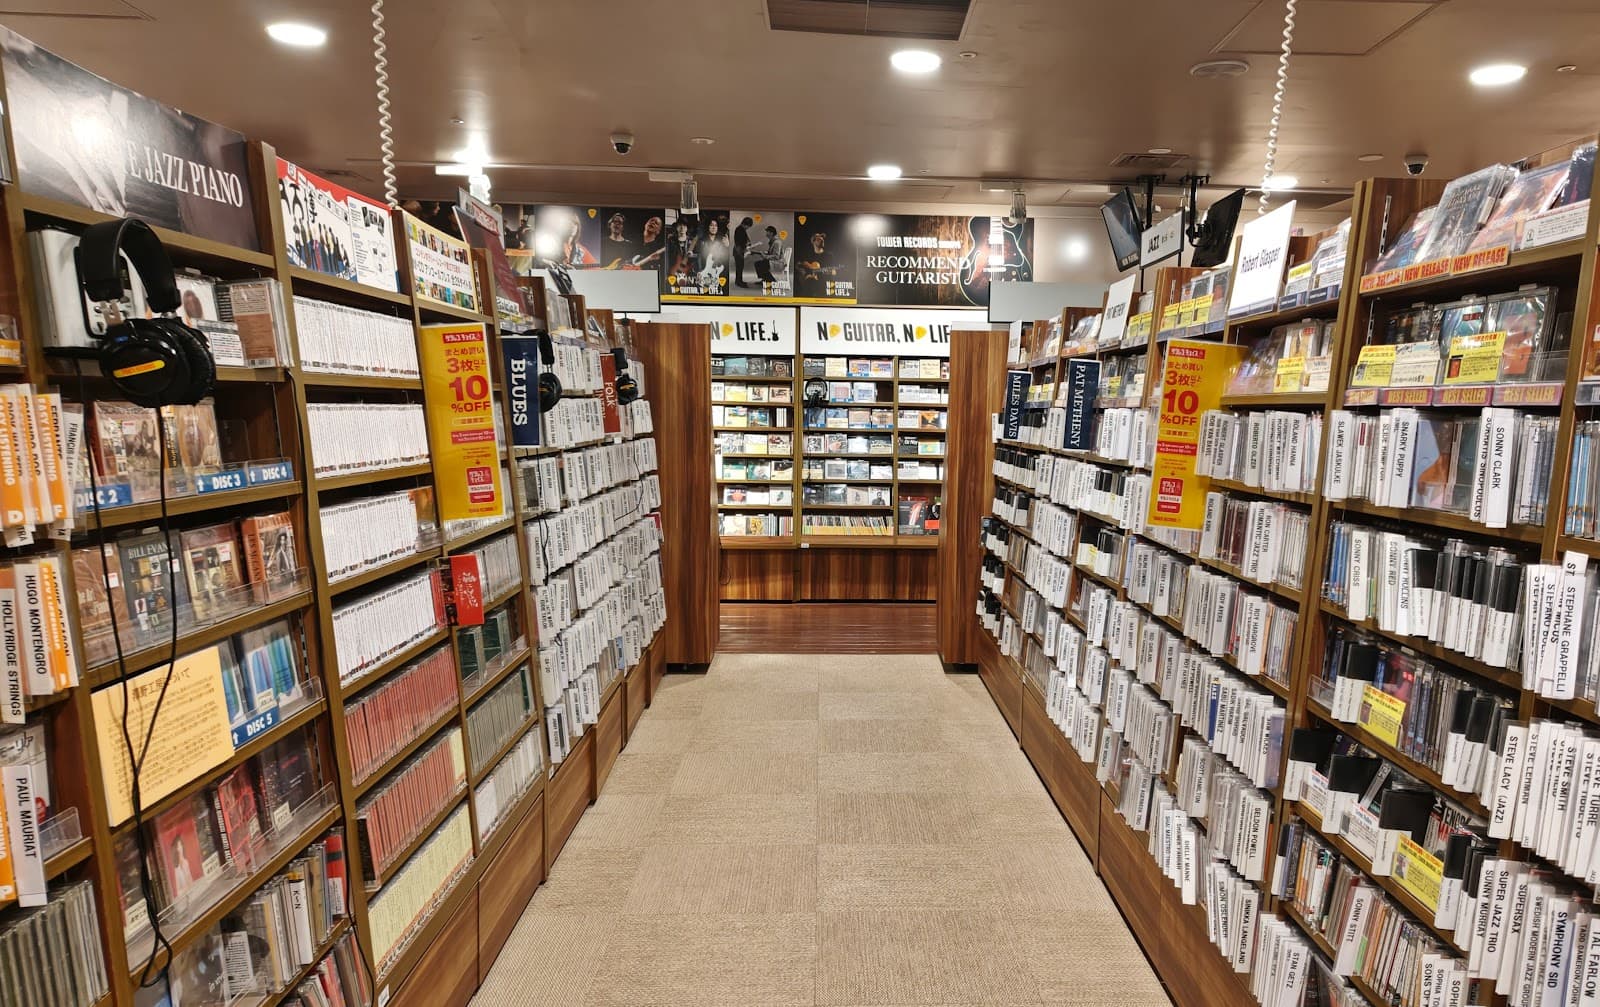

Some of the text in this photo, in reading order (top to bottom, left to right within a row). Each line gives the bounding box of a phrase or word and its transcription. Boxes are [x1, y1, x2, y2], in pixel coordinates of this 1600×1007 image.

[144, 146, 188, 193] JAZZ
[188, 160, 243, 208] PIANO
[877, 236, 902, 248] TOWER
[904, 236, 938, 249] RECORDS
[866, 255, 970, 269] RECOMMEND
[1241, 245, 1282, 275] Robert Glasper
[1404, 259, 1449, 282] NEW RELEASE
[1453, 247, 1506, 272] NEW RELEASE
[876, 271, 960, 285] GUITARIST
[736, 321, 771, 341] LIFE.
[843, 322, 901, 344] GUITAR,
[929, 324, 951, 343] LIF
[449, 375, 489, 401] 10
[510, 358, 528, 426] BLUES
[604, 382, 616, 406] FOLK
[1164, 389, 1199, 415] 10
[451, 401, 491, 413] %OFF
[1008, 375, 1022, 439] MILES DAVIS
[1070, 364, 1086, 448] PAT METHENY
[1161, 414, 1198, 426] %OFF
[1290, 419, 1300, 467] ROLAND HANNA
[1334, 420, 1345, 484] SLAWEK JASKULKE
[1396, 420, 1410, 478] SNARKY PUPPY
[1491, 426, 1504, 490] SONNY CLARK
[212, 473, 242, 490] DISC 3
[262, 466, 288, 481] DISC 4
[108, 489, 118, 503] 2
[1206, 498, 1214, 519] ROLAND
[1255, 508, 1264, 541] ROMANTIC
[1252, 542, 1260, 558] JAZZ
[1262, 530, 1270, 553] CARTER
[1352, 538, 1362, 588] SONNY CRISS
[1388, 570, 1398, 586] RED
[1566, 562, 1576, 577] ST
[25, 575, 48, 675] HUGO MONTENGRO
[1216, 606, 1224, 623] AYERS
[1550, 611, 1562, 644] MICUS
[1250, 622, 1260, 653] HARGROVE
[1556, 586, 1576, 692] STEPHANE GRAPPELLI
[2, 600, 22, 716] HOLLYRIDGE STRINGS
[246, 713, 273, 737] DISC 5
[1217, 703, 1226, 734] MARTINEZ
[1194, 758, 1206, 804] SCOTT HAMILTON
[1494, 736, 1518, 824] STEVE LACY (JAZZ)
[1521, 734, 1539, 805] STEVE LEHMAN
[1558, 746, 1577, 812] STEVE SMITH
[1582, 752, 1594, 790] STEVE
[16, 778, 37, 858] PAUL MAURIAT
[1586, 793, 1600, 827] TURRE
[1249, 807, 1262, 859] SELDON POWELL
[1218, 881, 1227, 902] SIMON
[1476, 870, 1494, 939] SUNNY MURRAY
[1346, 898, 1364, 942] SONNY STITT
[1487, 870, 1509, 953] SUPER JAZZ TRIO
[1511, 884, 1528, 935] SUPERSAX
[1532, 896, 1544, 930] SWEDISH
[1238, 898, 1252, 964] SINIKKA LANGELAND
[1528, 930, 1540, 962] MODERN
[1580, 924, 1588, 944] TADD
[1547, 911, 1568, 989] SYMPHONY SID
[1584, 930, 1600, 1000] TAL FARLOW
[1286, 952, 1300, 989] STAN GETZ
[1424, 962, 1434, 983] SONS
[1524, 963, 1536, 982] JAZZ
